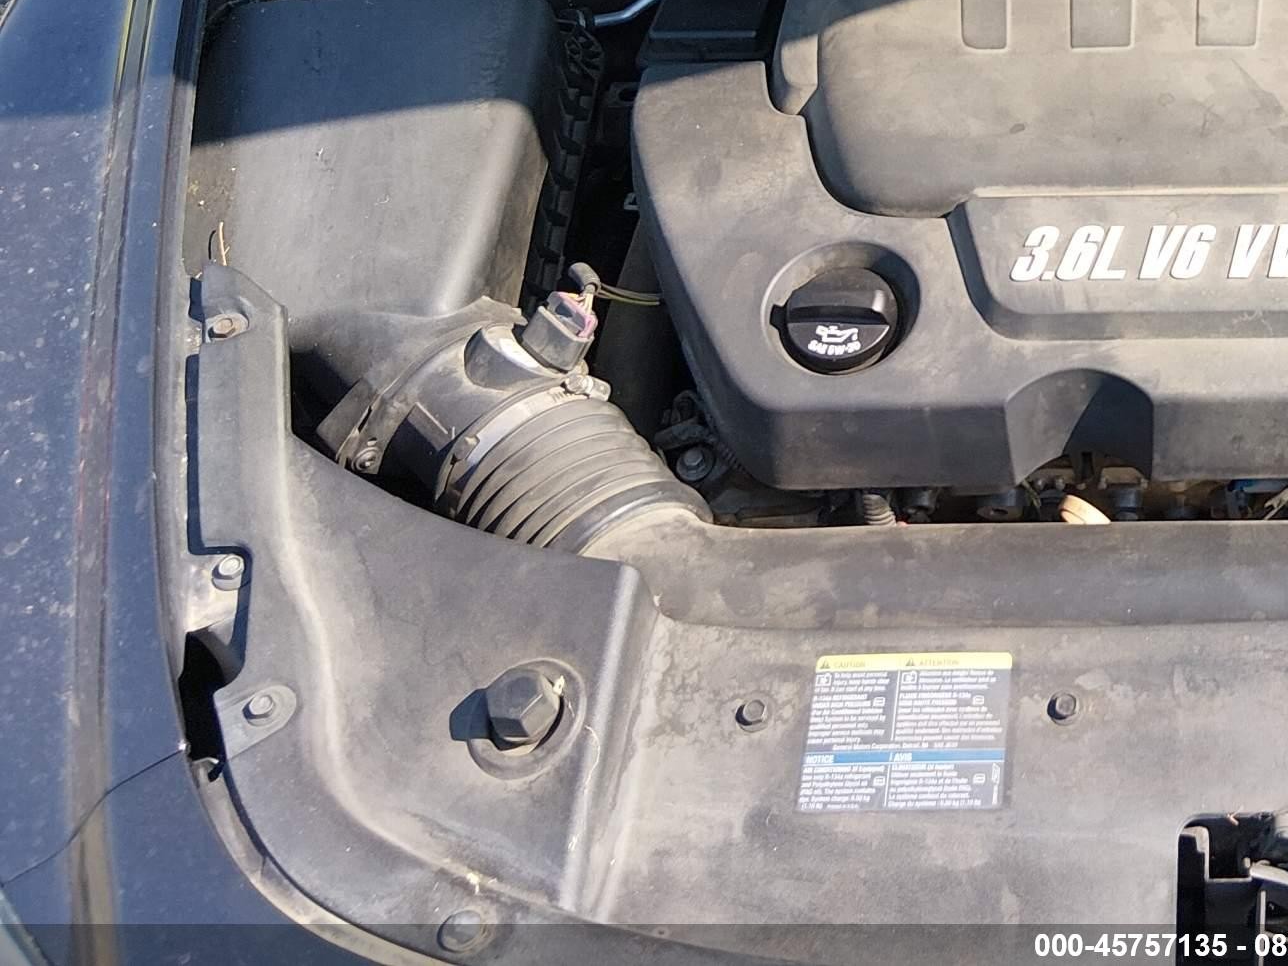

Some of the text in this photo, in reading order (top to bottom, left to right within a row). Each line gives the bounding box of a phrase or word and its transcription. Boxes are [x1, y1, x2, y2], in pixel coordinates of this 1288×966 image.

[1010, 225, 1127, 281] 3.6L
[1138, 224, 1216, 280] V6
[834, 660, 865, 668] CAUTION
[919, 658, 959, 666] ATTENTION
[806, 754, 834, 763] NOTICE
[894, 752, 912, 762] AVIS
